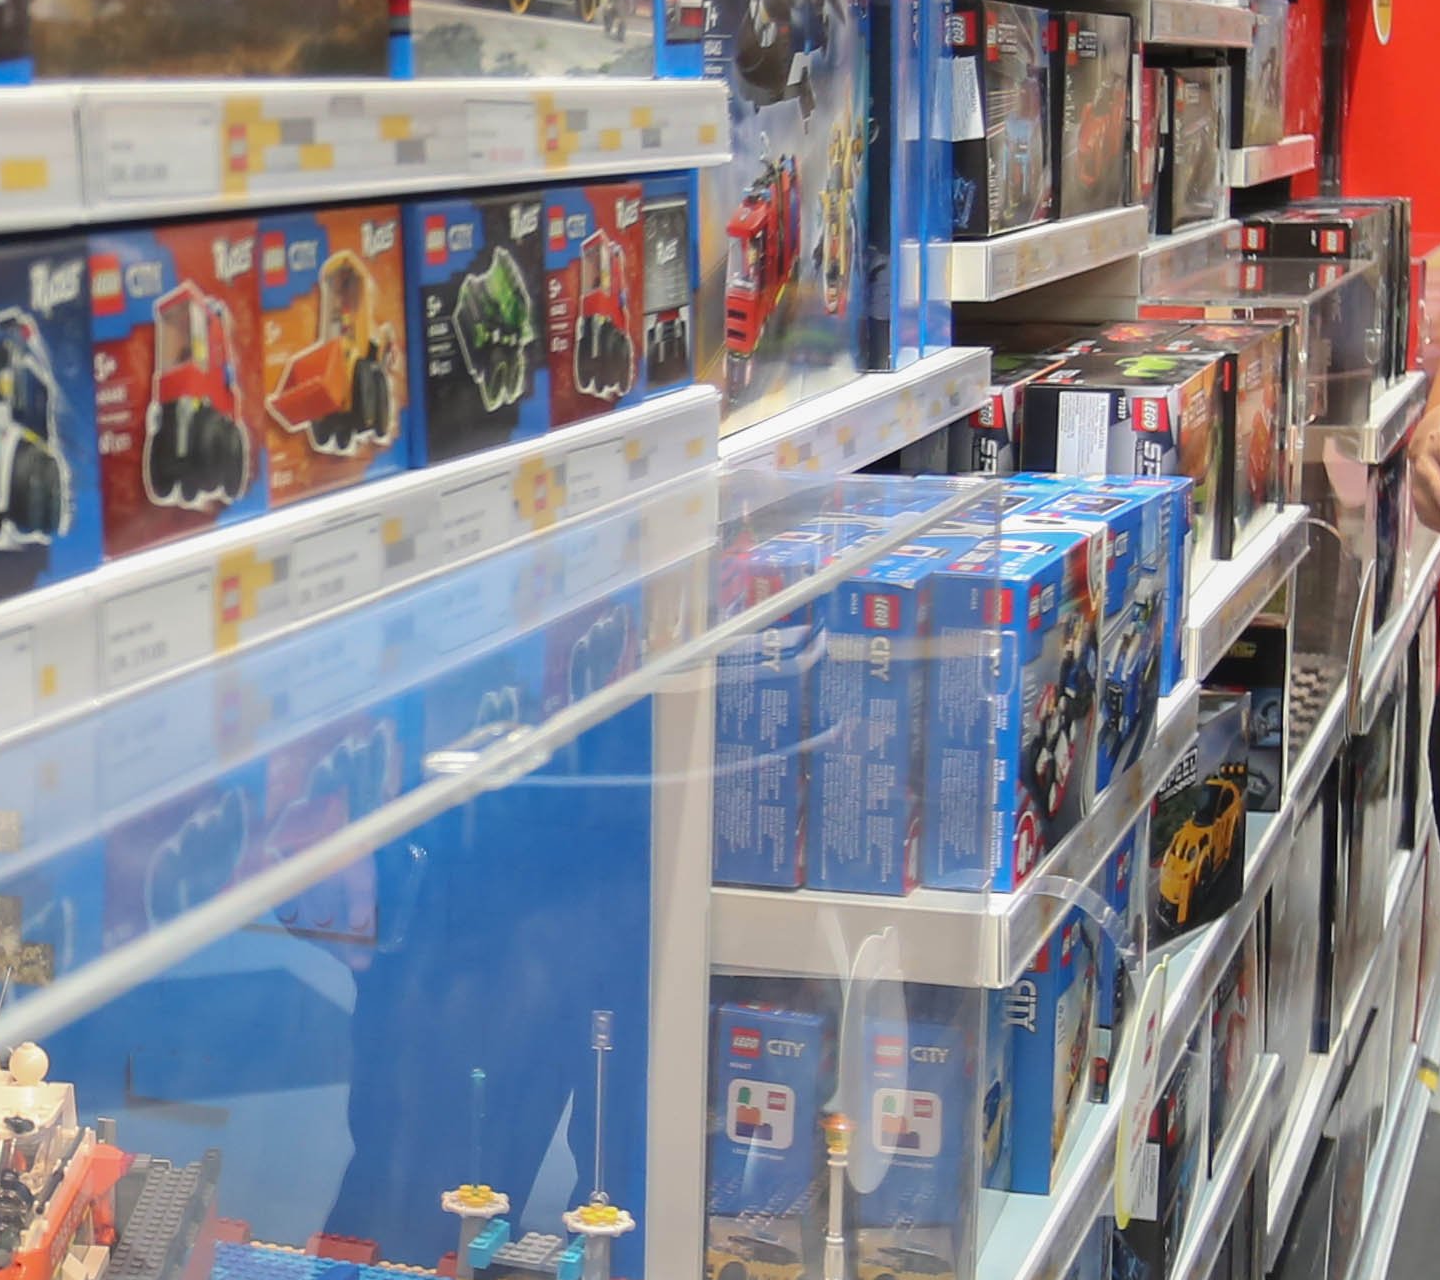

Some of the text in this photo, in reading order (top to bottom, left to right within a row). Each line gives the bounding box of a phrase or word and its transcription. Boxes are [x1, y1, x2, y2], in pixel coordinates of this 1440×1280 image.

[703, 0, 718, 32] 7+
[447, 223, 474, 251] CITY
[287, 239, 318, 271] CITY
[125, 259, 164, 298] CITY
[1144, 400, 1158, 431] LEGO
[872, 596, 891, 627] LEGO
[762, 629, 781, 671] CITY
[871, 636, 891, 681] CITY
[1006, 979, 1036, 1033] CITY
[732, 1036, 806, 1058] LEGO CITY
[910, 1047, 950, 1064] CITY
